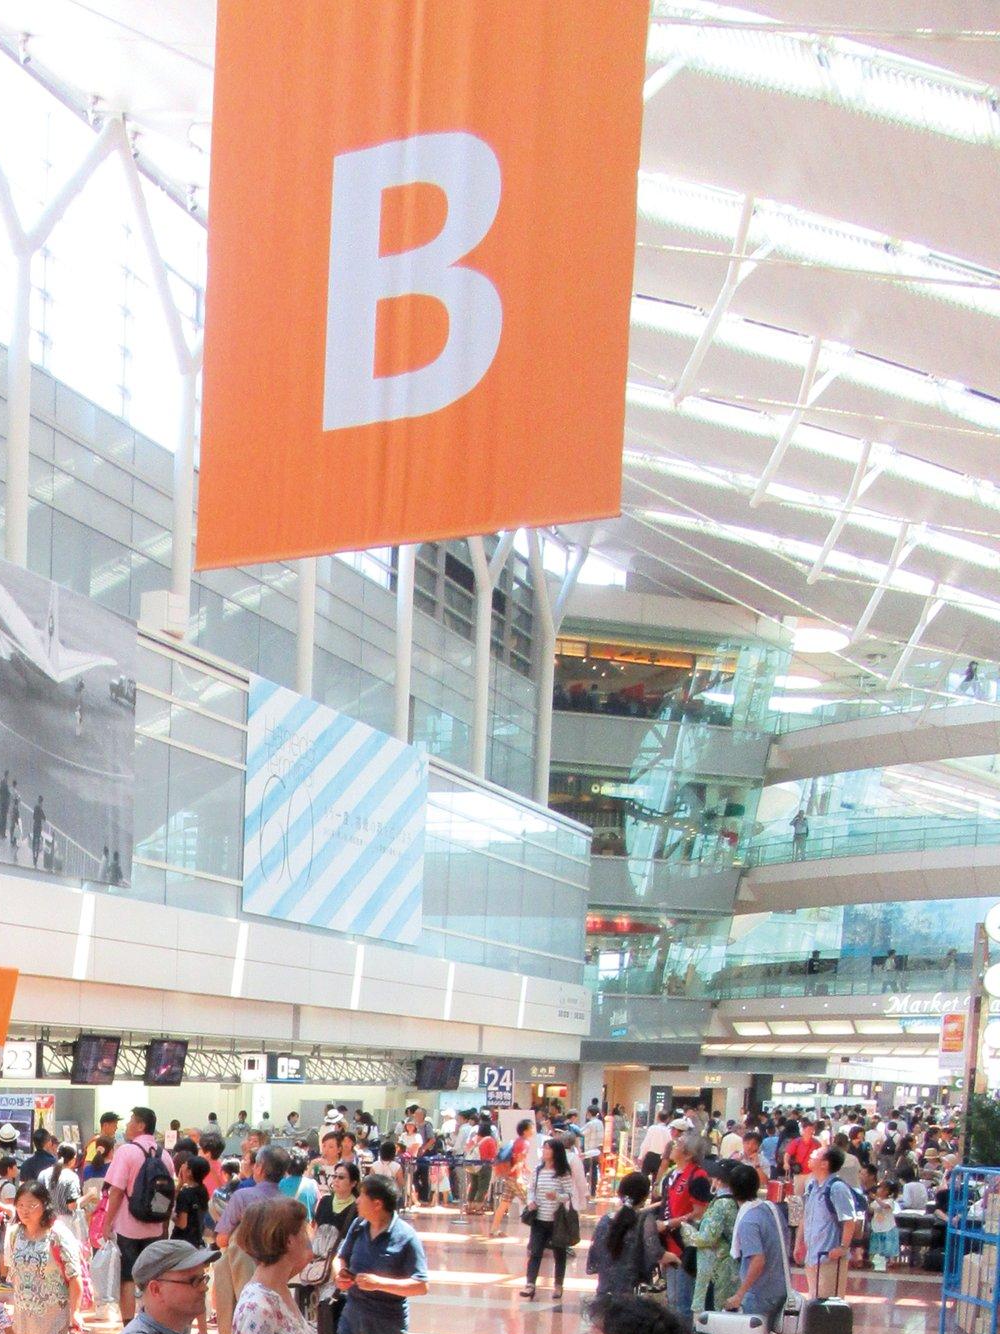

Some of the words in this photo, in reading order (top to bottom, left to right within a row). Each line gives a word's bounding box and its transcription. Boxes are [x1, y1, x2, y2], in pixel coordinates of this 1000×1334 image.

[323, 130, 503, 432] B
[883, 991, 960, 1014] Market
[487, 1069, 513, 1092] 24
[487, 1091, 513, 1101] 手荷物
